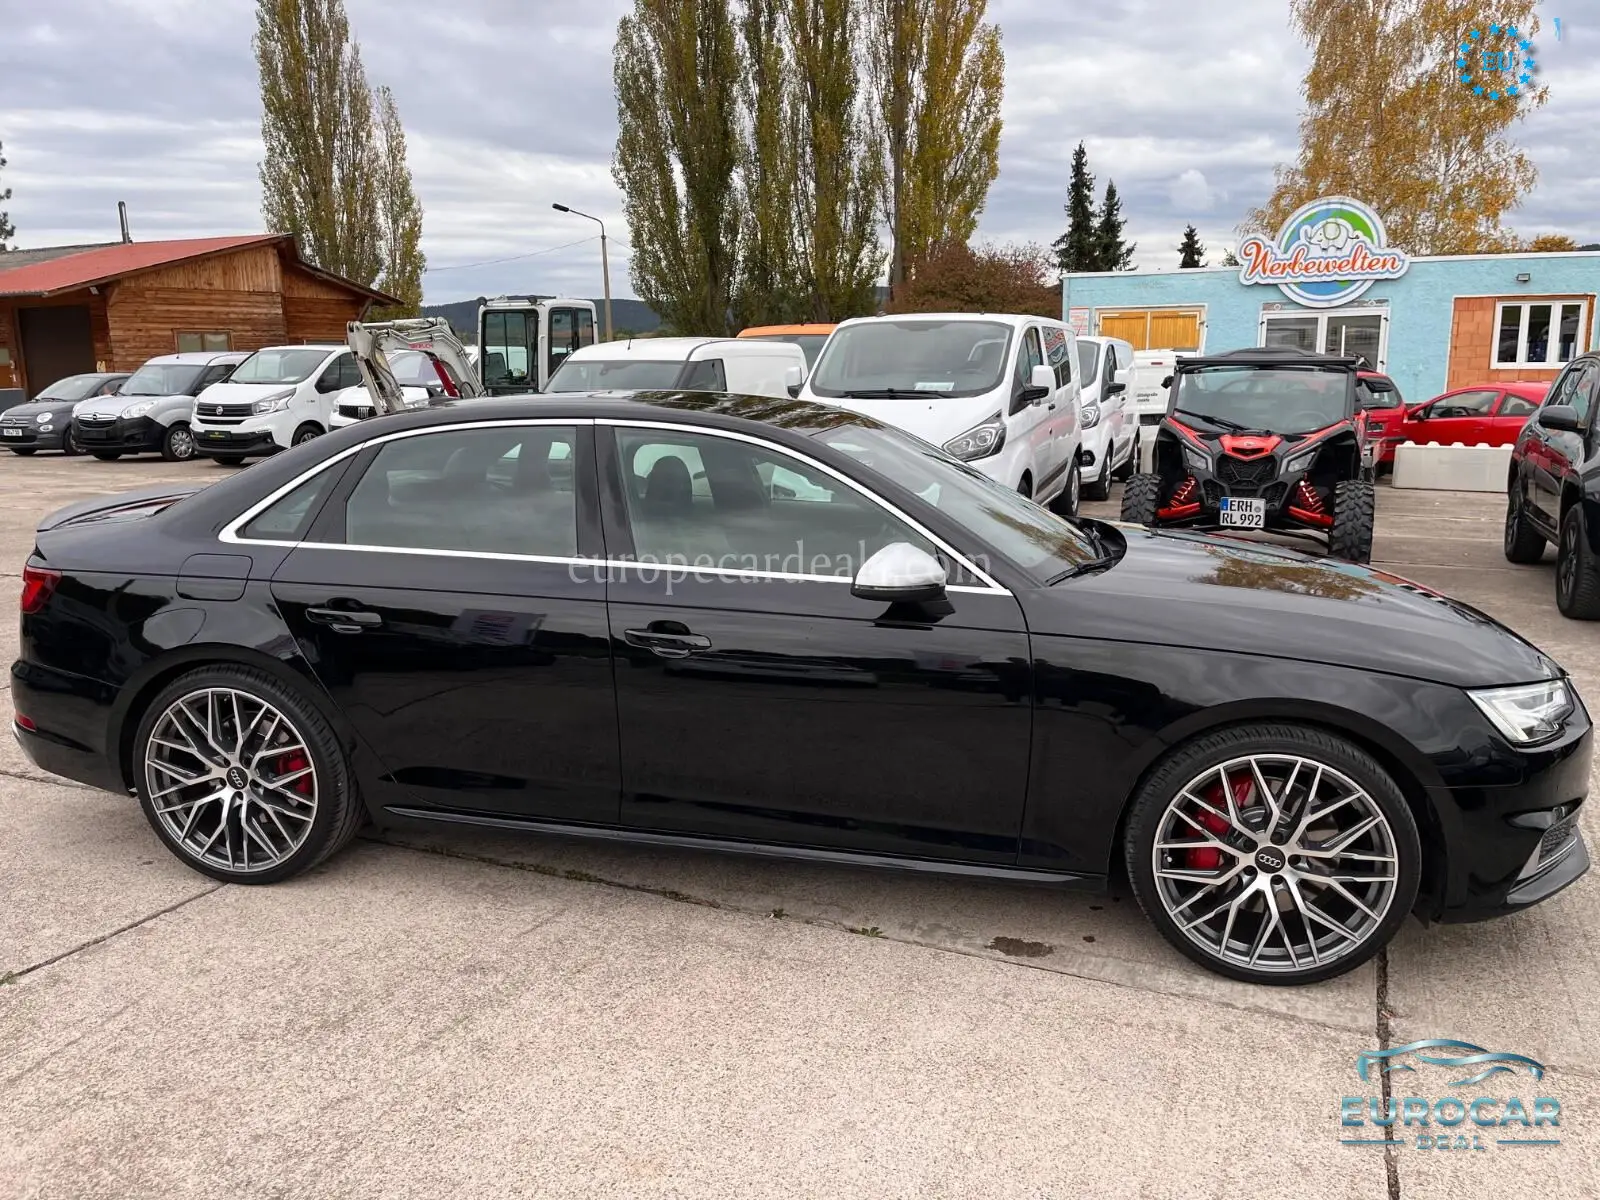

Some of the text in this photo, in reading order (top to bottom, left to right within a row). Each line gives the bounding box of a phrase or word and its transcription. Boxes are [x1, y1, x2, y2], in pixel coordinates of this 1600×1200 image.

[1243, 239, 1400, 278] Werbewelten
[1229, 500, 1253, 512] ERH
[1222, 513, 1262, 526] RL 992
